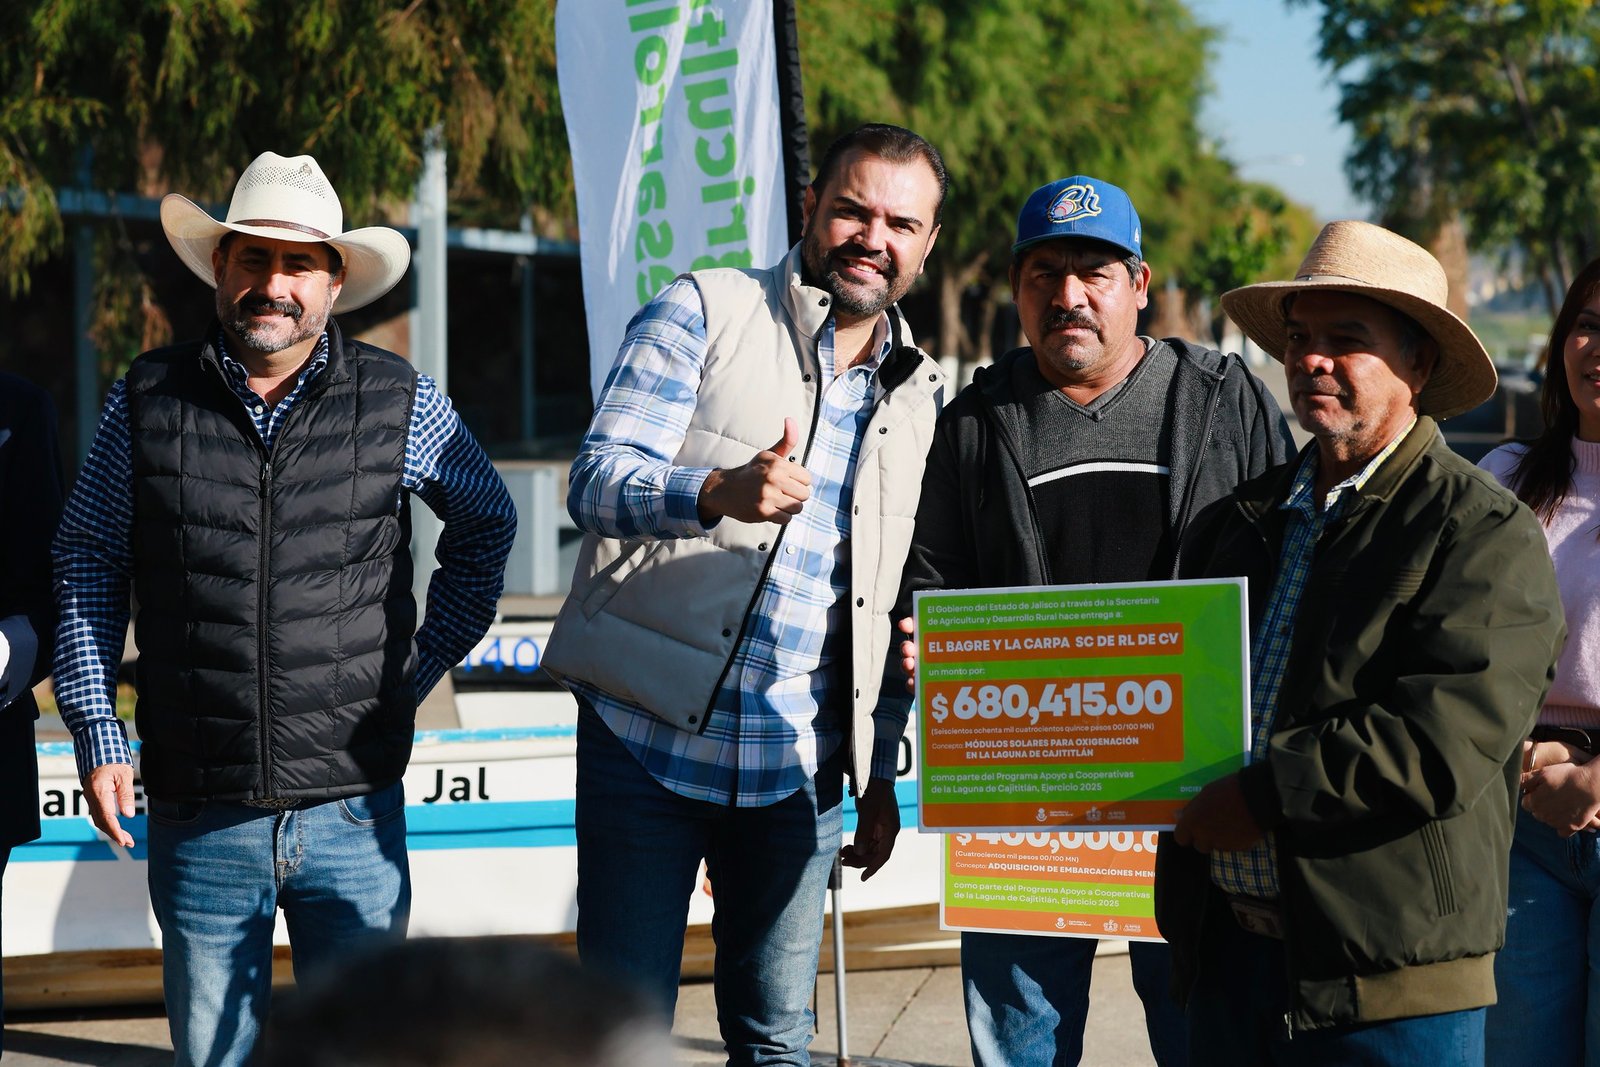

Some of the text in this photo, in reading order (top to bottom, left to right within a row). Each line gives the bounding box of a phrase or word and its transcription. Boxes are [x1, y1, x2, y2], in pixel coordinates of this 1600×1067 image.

[936, 604, 974, 613] Gobierno
[990, 602, 1017, 610] Estado
[1031, 601, 1059, 609] Jalisco
[1067, 600, 1093, 608] través
[1116, 597, 1160, 606] Secretaría
[940, 616, 984, 626] Agricultura
[993, 614, 1034, 622] Desarrollo
[928, 633, 1178, 652] EL BAGRE Y LA CARPA SC DE RL DE CV
[969, 668, 985, 676] por:
[931, 728, 973, 736] (Seiscientos
[1140, 723, 1155, 731] MN)
[965, 739, 1008, 748] MÓDULOS
[1010, 739, 1048, 748] SOLARES
[1076, 736, 1139, 746] OXIGENACIÓN
[992, 750, 1027, 758] LAGUNA
[1042, 747, 1093, 757] CAJITITLÁN
[957, 773, 980, 782] parte
[997, 772, 1038, 782] Programa
[1040, 772, 1067, 781] Apoyo
[1076, 770, 1134, 779] Cooperativas
[422, 767, 490, 804] Jal
[932, 785, 942, 793] de
[944, 785, 951, 793] la
[953, 785, 984, 794] Laguna
[1042, 783, 1078, 793] Ejercicio
[955, 850, 1006, 859] (Cuatrocientos
[988, 862, 1045, 872] ADQUISICION
[975, 893, 1005, 901] Laguna
[1018, 885, 1058, 894] Programa
[1060, 888, 1086, 896] Apoyo
[1094, 889, 1150, 899] Cooperativas
